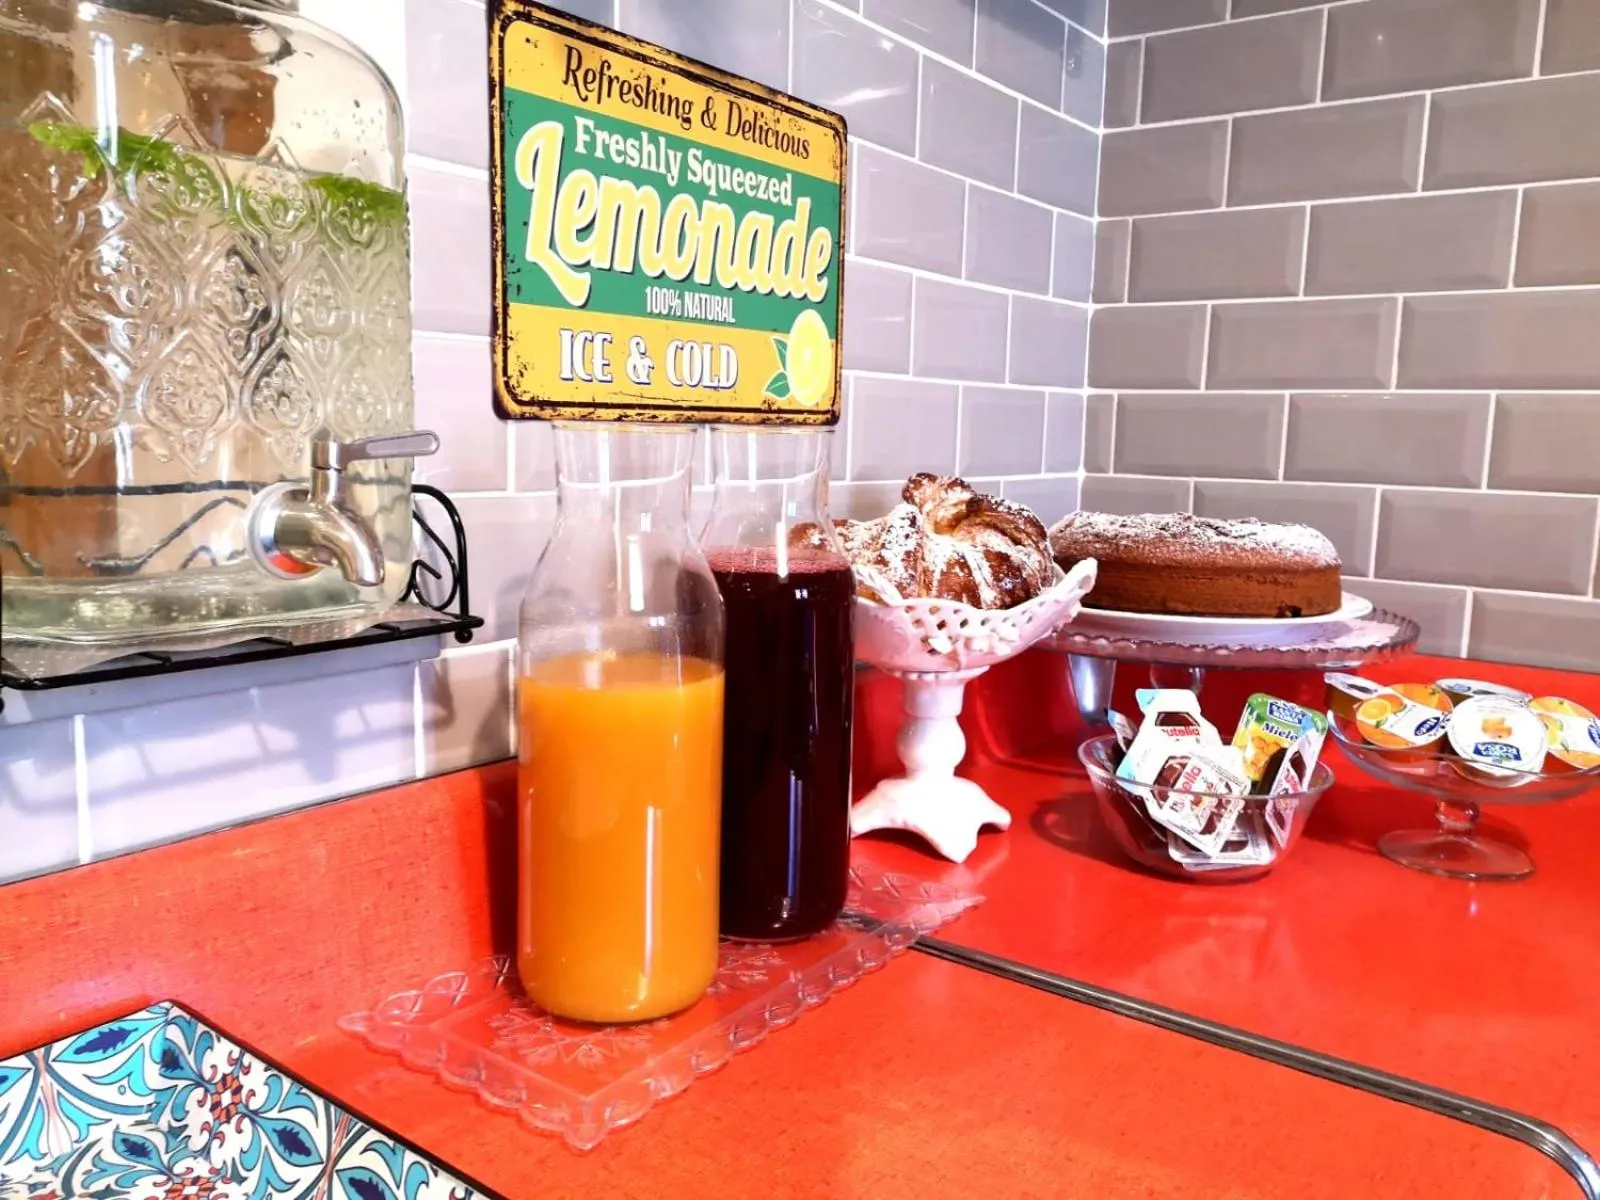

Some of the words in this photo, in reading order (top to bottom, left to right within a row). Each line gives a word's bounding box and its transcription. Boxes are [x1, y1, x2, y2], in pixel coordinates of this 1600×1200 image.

[562, 44, 694, 131] Refreshing
[700, 96, 717, 130] &
[724, 99, 811, 160] Delicious
[573, 115, 684, 187] Freshly
[687, 148, 793, 206] Squeezed
[514, 119, 833, 308] Lemonade
[645, 286, 682, 317] 100%
[684, 290, 736, 323] NATURAL
[558, 328, 614, 384] ICE
[626, 335, 655, 385] &
[666, 338, 739, 390] COLD
[1263, 722, 1298, 740] Miele
